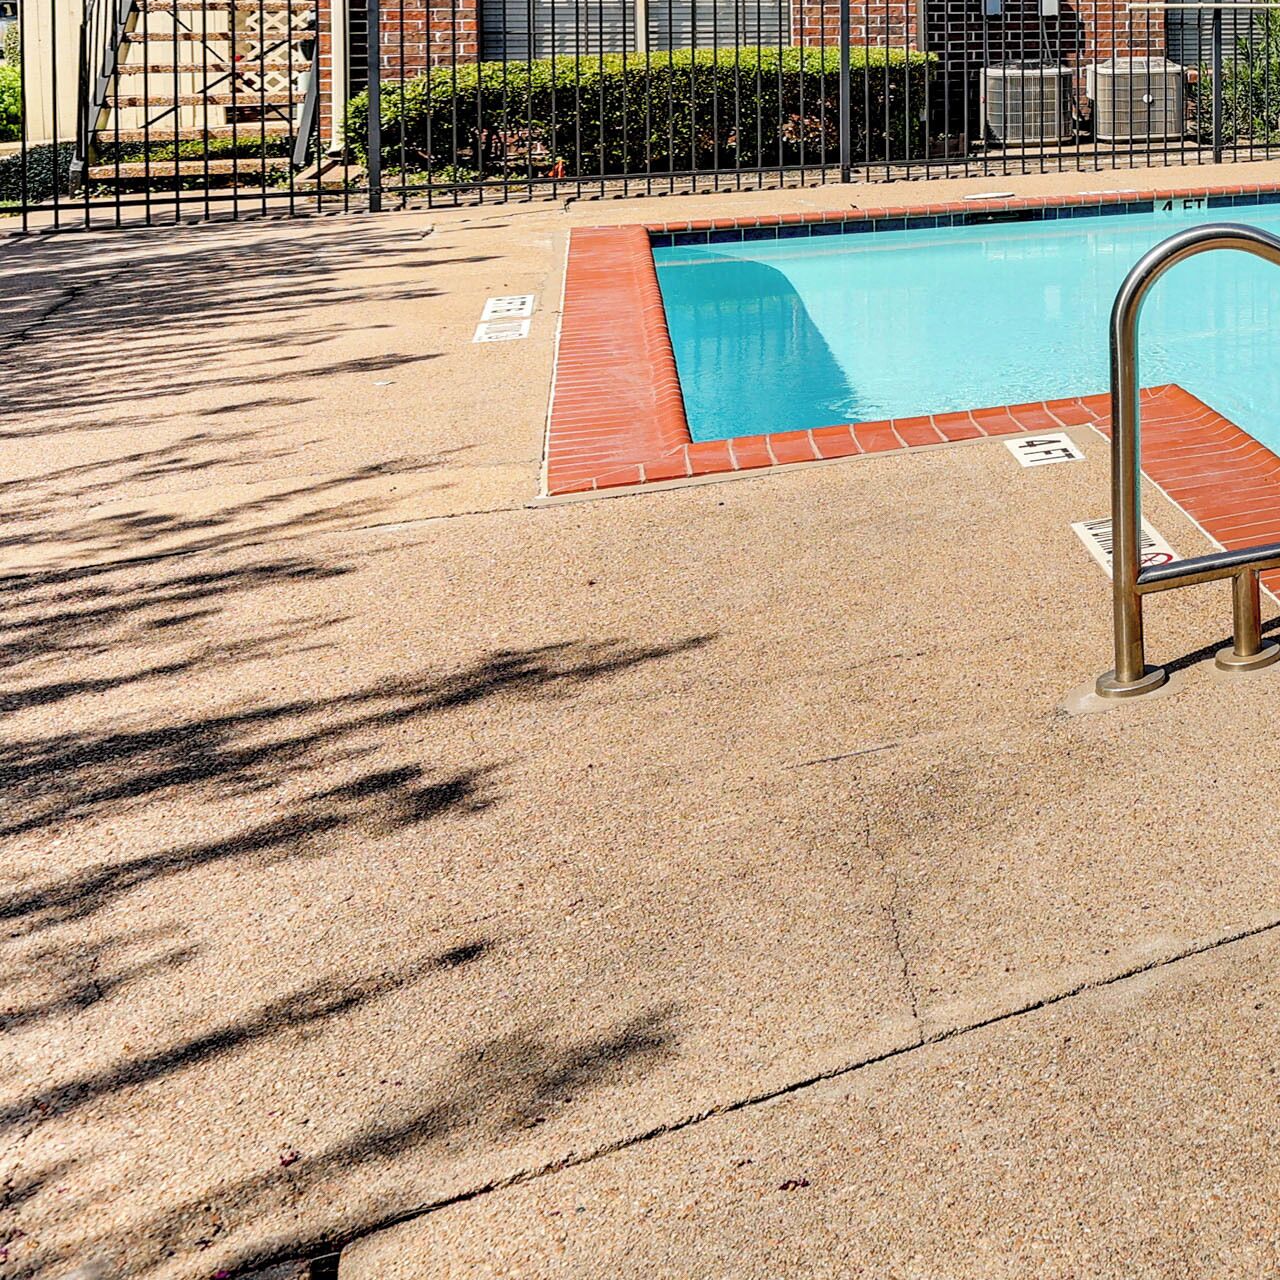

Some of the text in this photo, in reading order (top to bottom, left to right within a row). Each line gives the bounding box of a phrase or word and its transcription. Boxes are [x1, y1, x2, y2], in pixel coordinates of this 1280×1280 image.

[1183, 199, 1205, 210] FT
[1018, 439, 1075, 462] 4 FT
